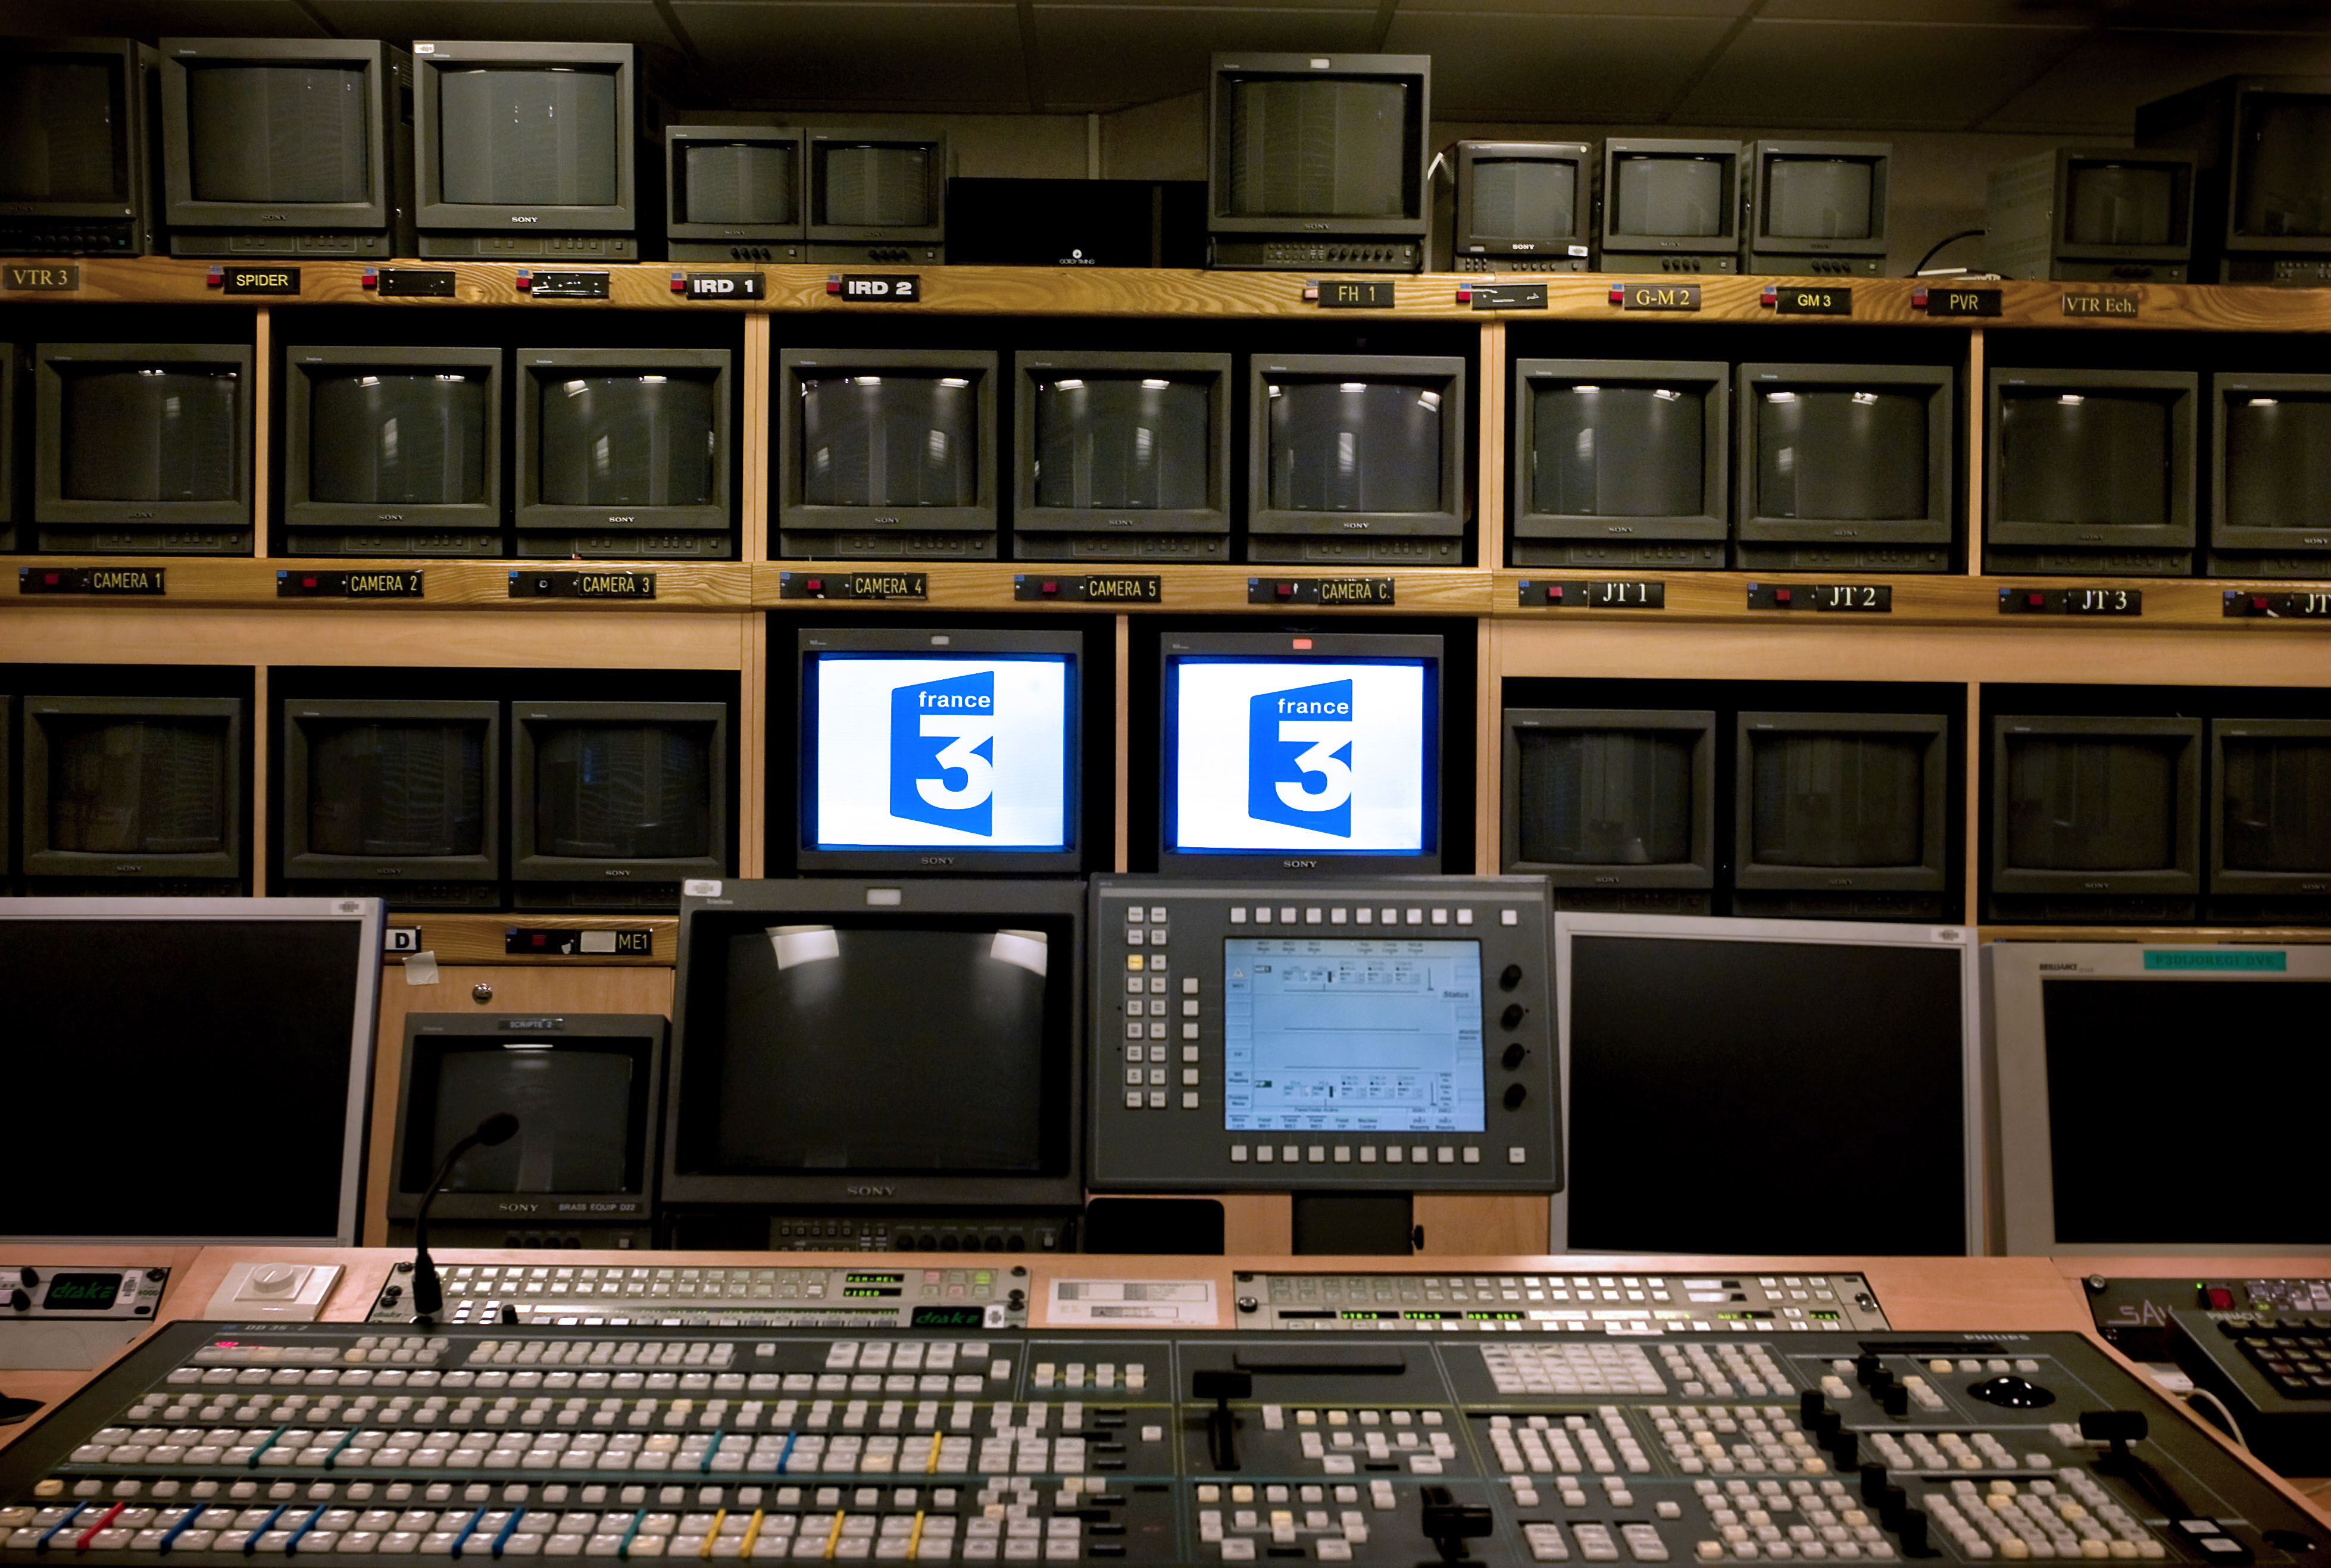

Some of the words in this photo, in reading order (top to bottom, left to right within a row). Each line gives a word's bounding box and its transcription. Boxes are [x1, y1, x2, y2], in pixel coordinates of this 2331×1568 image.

[13, 270, 54, 285] VTR
[58, 270, 68, 286] 3
[236, 274, 289, 286] SPIDER
[693, 279, 735, 293] IRD
[745, 279, 754, 293] 1
[848, 281, 889, 295] IRD
[896, 282, 913, 295] 2
[1339, 286, 1359, 301] FH
[1368, 286, 1375, 301] 1
[1636, 289, 1674, 305] G-M
[1680, 289, 1690, 305] 2
[1798, 293, 1820, 307] GM
[1823, 295, 1832, 307] 3
[1950, 293, 1979, 310] PVR
[2067, 297, 2101, 312] VTR
[2106, 298, 2136, 313] Ech.
[93, 573, 149, 588] CAMERA
[155, 573, 161, 588] 1
[351, 576, 404, 592] CAMERA
[410, 576, 417, 591] 2
[583, 577, 636, 593] CAMERA
[642, 577, 650, 593] 3
[855, 578, 908, 594] CAMERA
[915, 579, 922, 594] 4
[1089, 580, 1142, 596] CAMERA
[1149, 581, 1156, 596] 5
[1322, 583, 1372, 599] CAMERA
[1603, 583, 1631, 602] JT
[1639, 583, 1648, 602] 1
[1830, 586, 1857, 606] JT
[1863, 586, 1876, 606] 2
[2082, 590, 2110, 610] JT
[2115, 591, 2127, 610] 3
[2305, 594, 2331, 614] JT
[918, 691, 991, 708] france
[1277, 698, 1349, 714] france
[915, 714, 993, 810] 3
[1274, 720, 1352, 812] 3
[395, 932, 410, 948] D
[618, 934, 648, 949] ME1
[2246, 955, 2274, 966] DVE
[510, 1020, 543, 1029] SCRIPTE
[546, 1020, 552, 1029] 2
[846, 1186, 896, 1197] SONY
[499, 1203, 539, 1212] SONY
[558, 1203, 587, 1211] BRASS
[590, 1203, 618, 1211] EQUIP
[620, 1203, 636, 1211] D22
[51, 1282, 116, 1299] drake
[2206, 1311, 2264, 1321] PINNACLE
